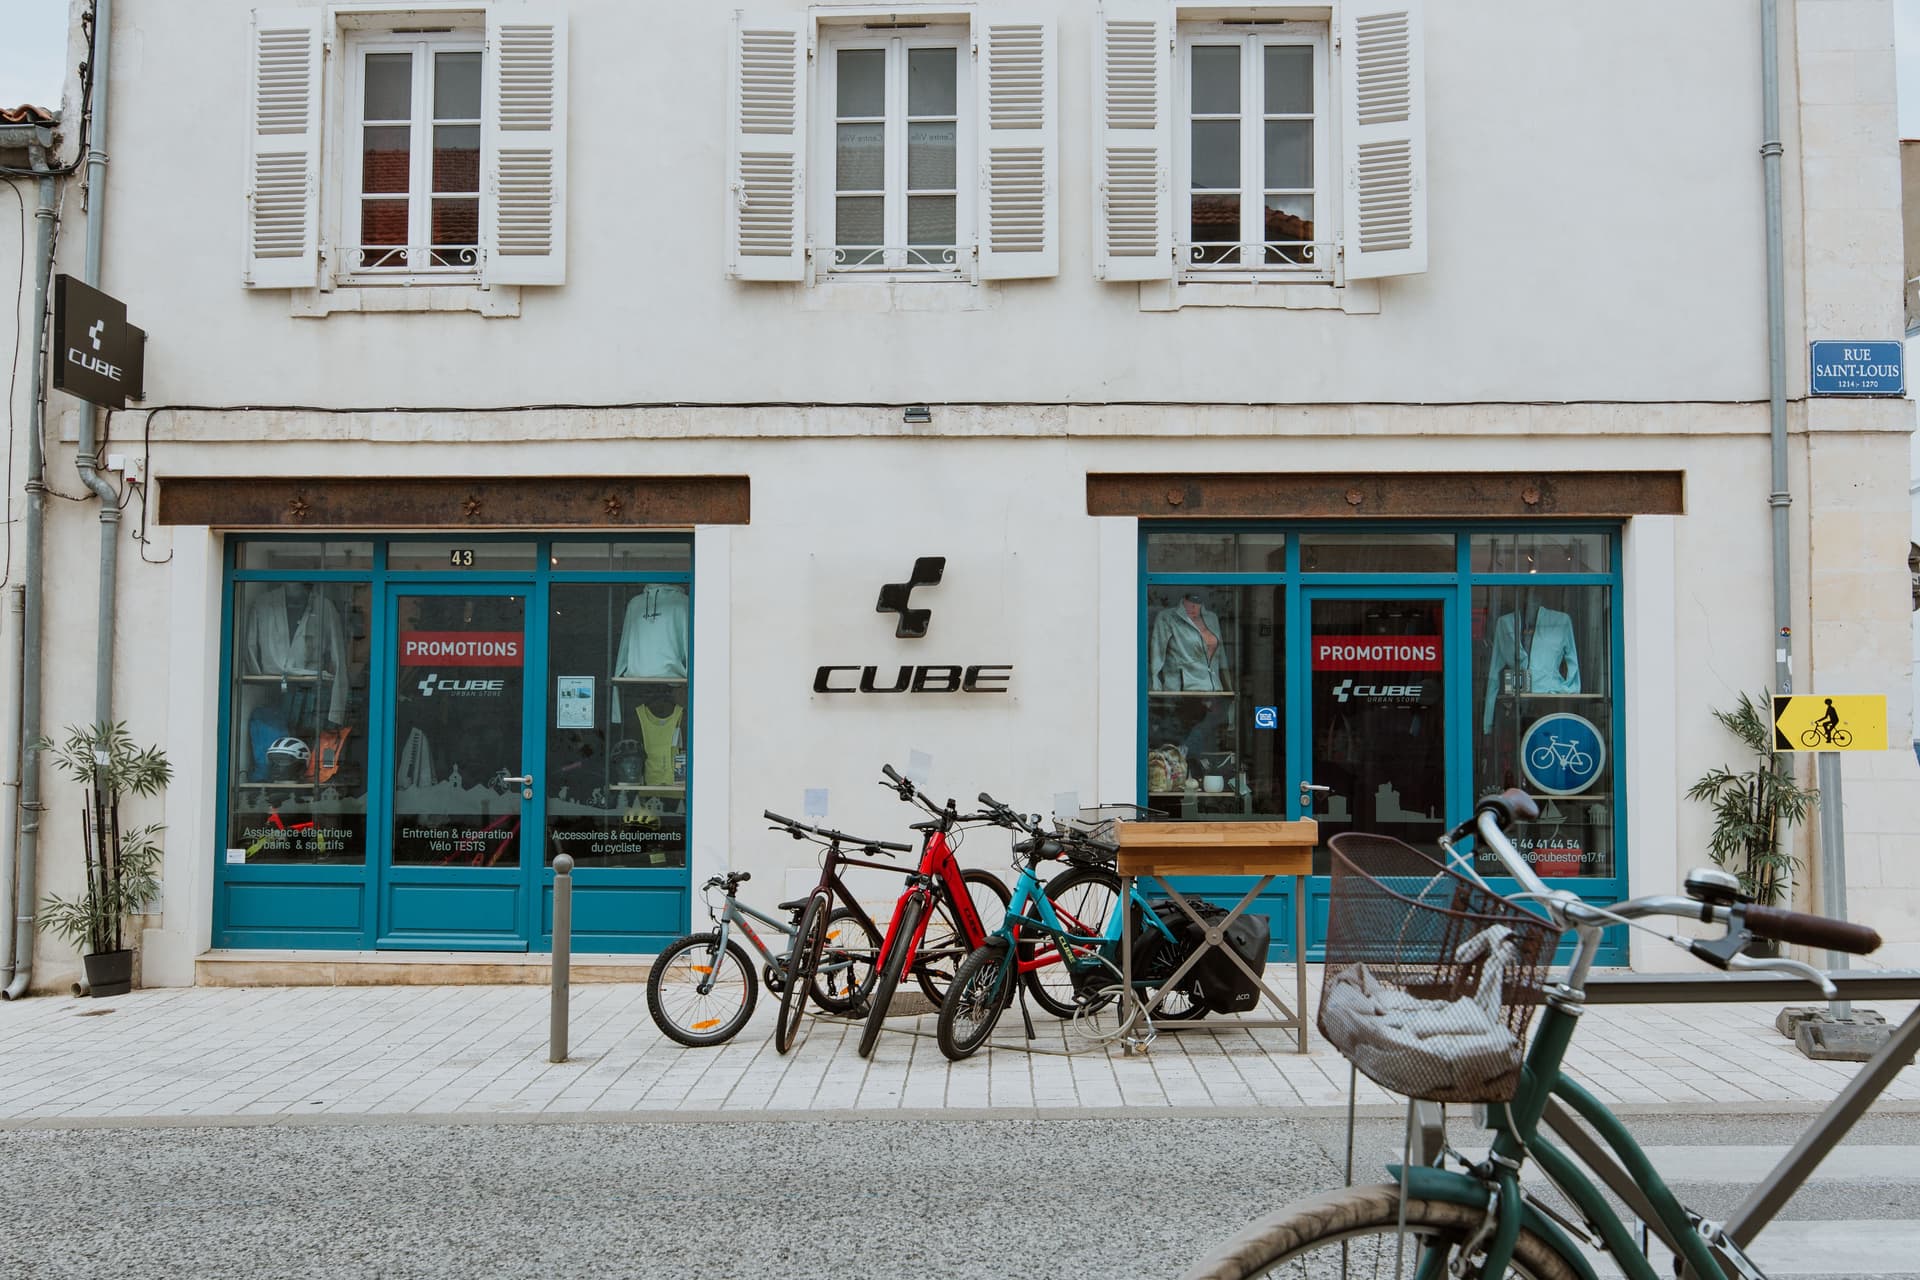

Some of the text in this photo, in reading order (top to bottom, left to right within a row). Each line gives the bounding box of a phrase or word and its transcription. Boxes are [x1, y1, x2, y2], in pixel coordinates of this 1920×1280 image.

[1843, 348, 1872, 361] RUE
[68, 347, 123, 382] CUBE
[1816, 364, 1900, 377] SAINT-LOUIS
[1838, 380, 1855, 388] 1214
[1862, 380, 1879, 388] 1270
[451, 550, 473, 566] 43
[406, 641, 517, 656] PROMOTIONS
[1320, 646, 1436, 661] PROMOTIONS
[438, 680, 505, 691] CUBE
[813, 665, 1013, 693] CUBE
[1353, 686, 1423, 696] CUBE
[243, 826, 353, 839] Assistance électrique
[402, 828, 514, 841] Entretien & réparation
[552, 830, 682, 842] Accessoires & équipements
[252, 839, 345, 852] bains & sportifs
[429, 841, 486, 852] Vélo TESTS
[591, 843, 642, 854] du cycliste
[1520, 839, 1534, 849] 46
[1536, 839, 1548, 849] 41
[1550, 840, 1564, 849] 44
[1566, 840, 1580, 850] 54
